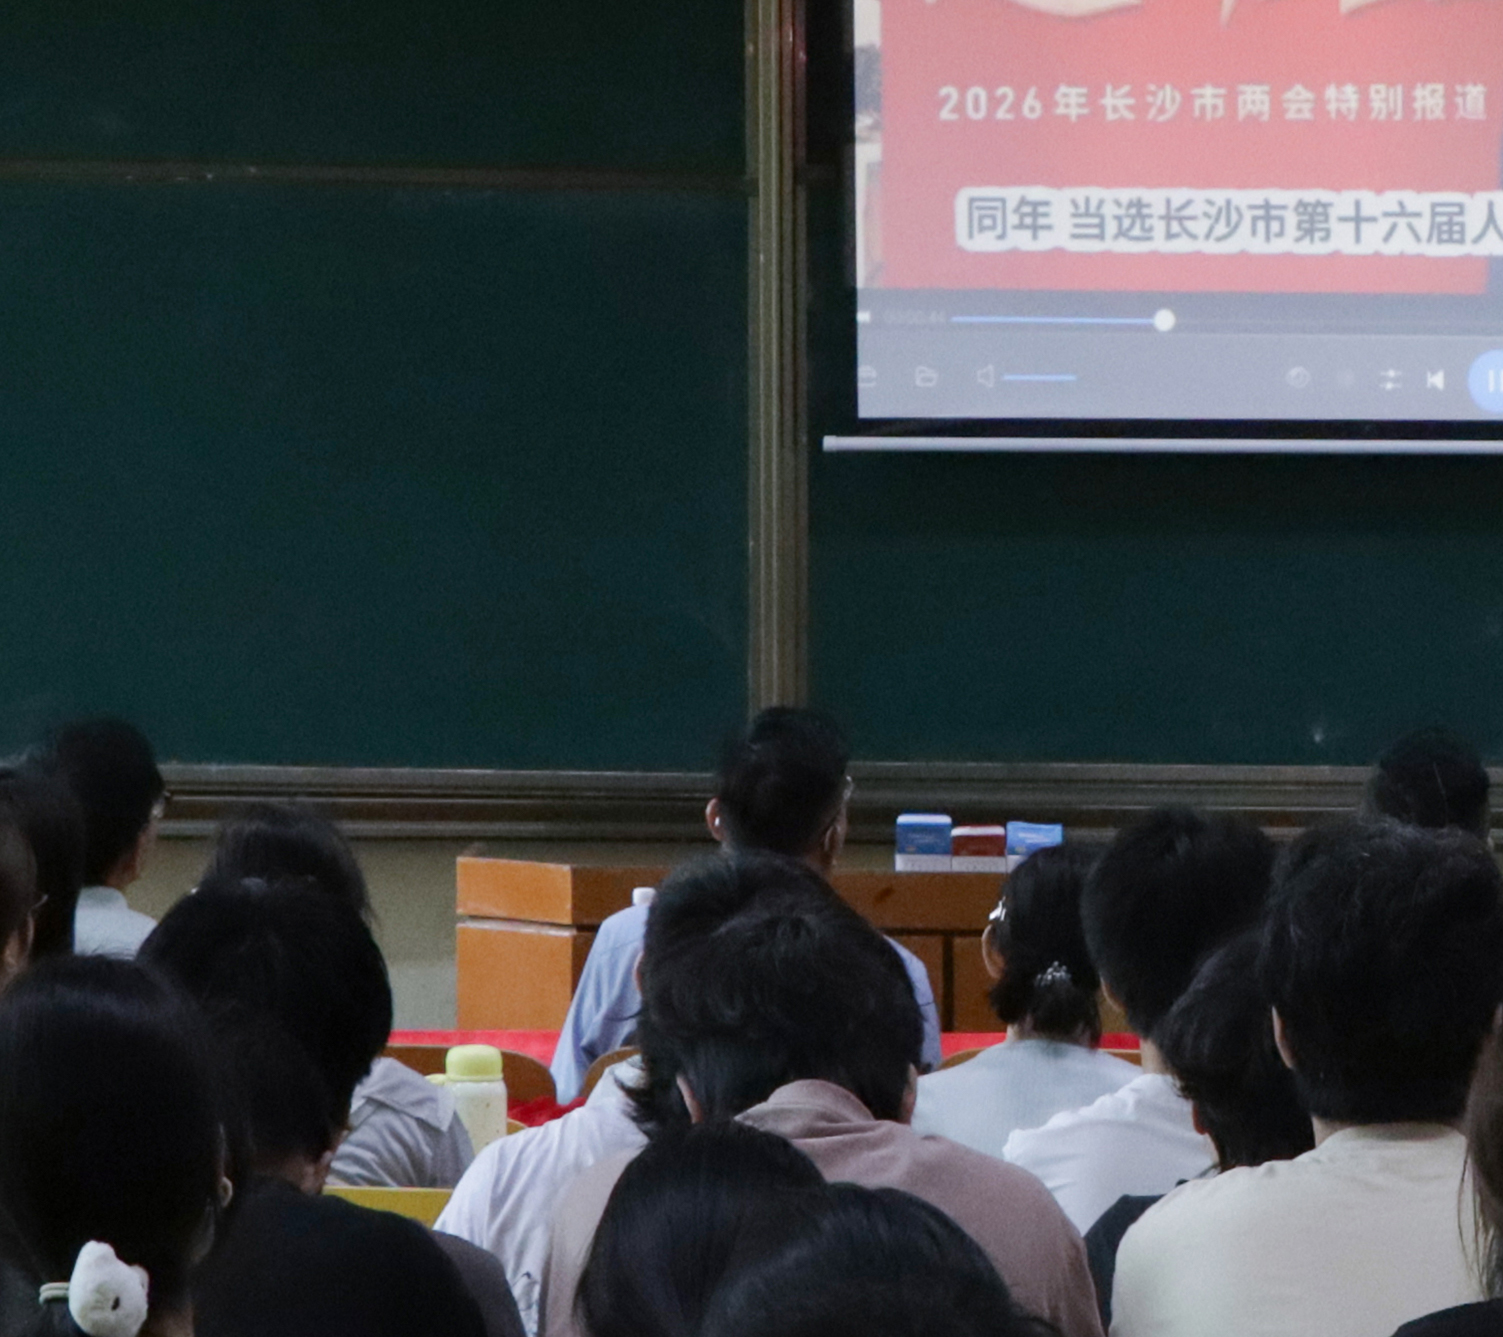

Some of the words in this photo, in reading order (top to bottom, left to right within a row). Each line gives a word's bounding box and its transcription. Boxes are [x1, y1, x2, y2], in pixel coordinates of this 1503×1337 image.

[937, 82, 1489, 124] 2026年长沙市两会特别报道
[966, 195, 1053, 241] 同年
